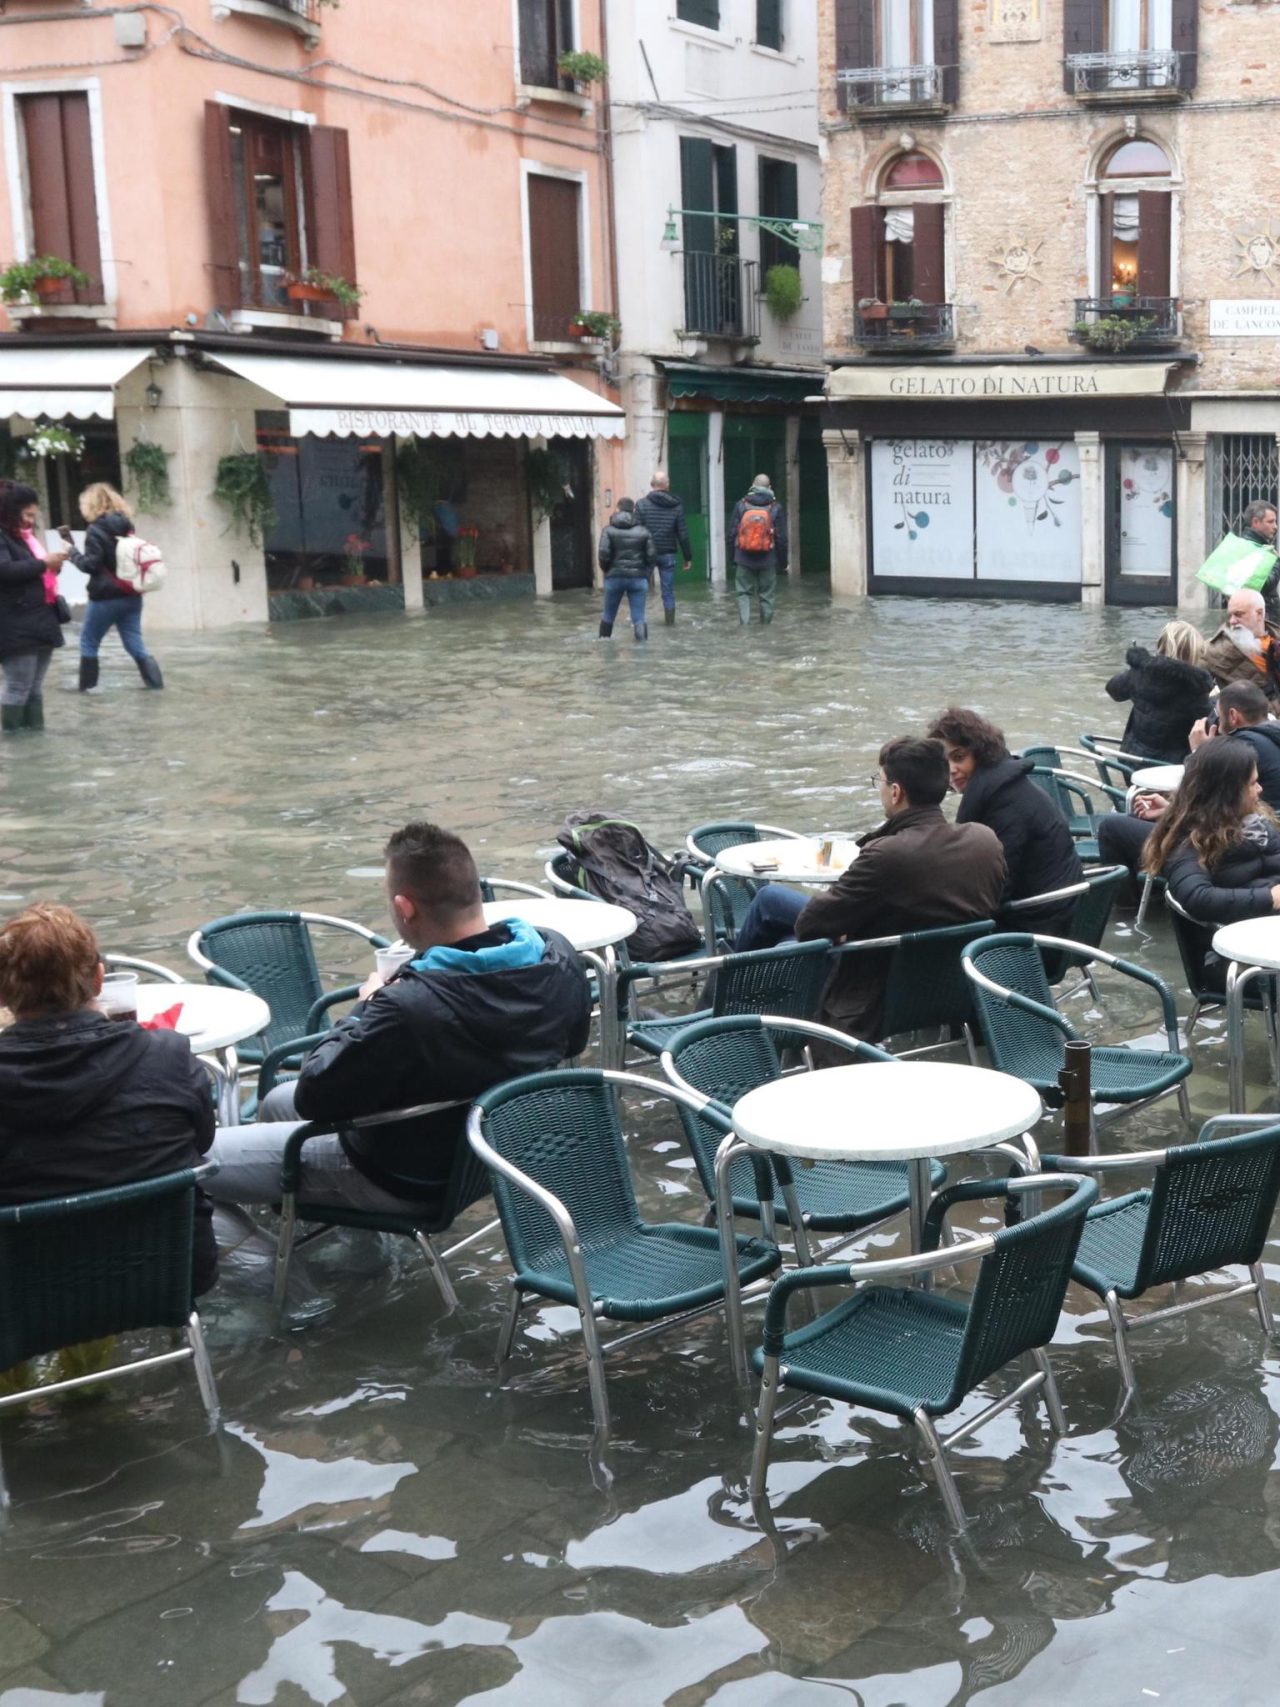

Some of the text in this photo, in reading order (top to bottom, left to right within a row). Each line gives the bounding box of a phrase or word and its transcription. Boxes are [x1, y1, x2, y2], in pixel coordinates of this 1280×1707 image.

[1213, 319, 1228, 329] DE
[889, 375, 1100, 394] GELATO DI NATURA
[337, 411, 596, 433] RISTORANTE AL TEATRO ITALIA
[893, 440, 947, 465] gelato
[893, 465, 911, 486] di
[893, 491, 951, 505] natura
